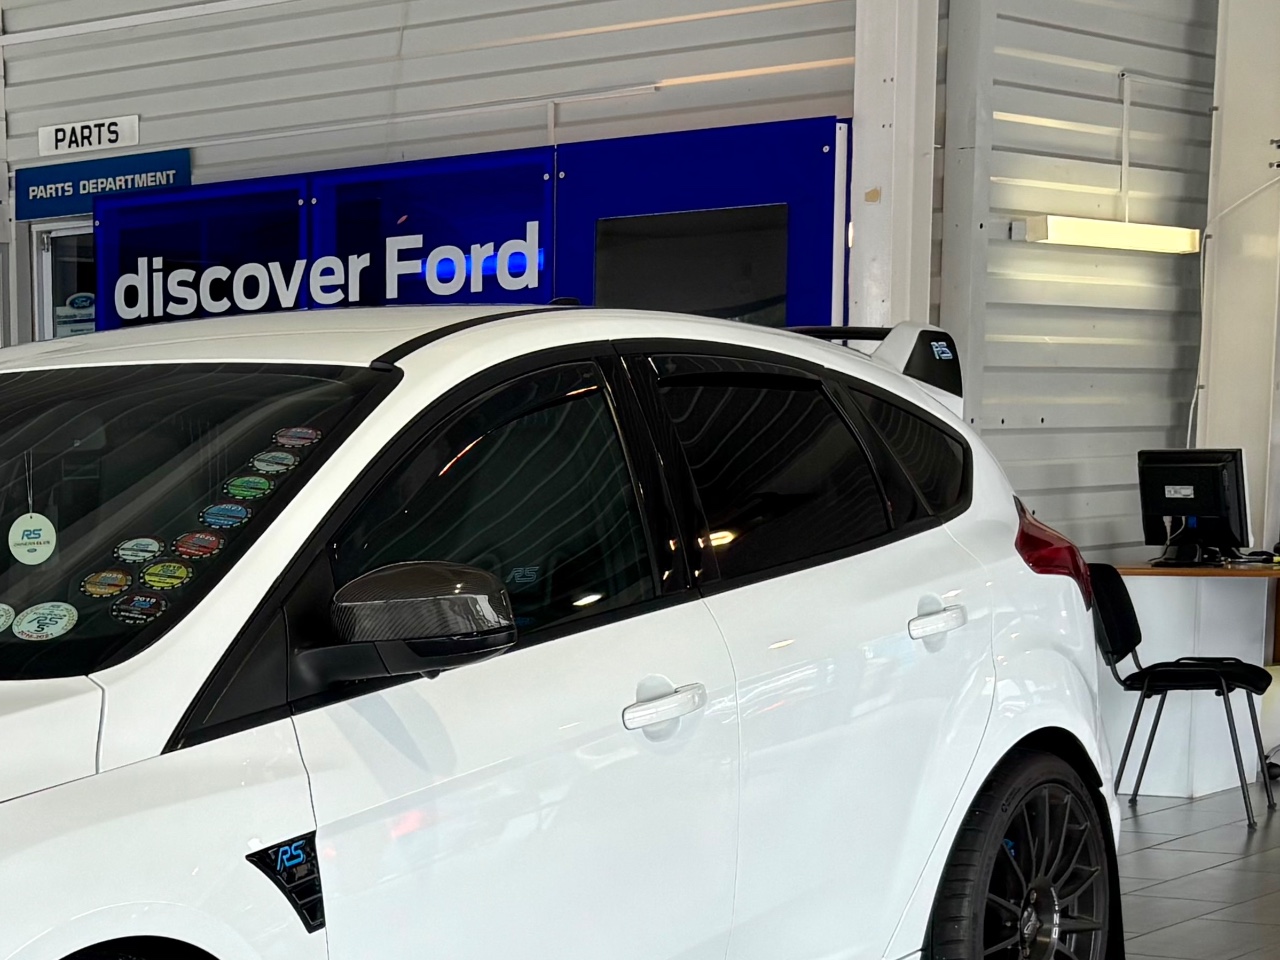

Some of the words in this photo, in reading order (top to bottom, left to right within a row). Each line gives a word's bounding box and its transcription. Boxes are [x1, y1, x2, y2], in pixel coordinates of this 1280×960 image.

[53, 121, 119, 150] PARTS
[28, 181, 74, 200] PARTS
[78, 169, 176, 195] DEPARTMENT
[114, 253, 370, 320] discover
[385, 220, 540, 299] Ford
[930, 341, 953, 360] RS
[21, 528, 43, 541] RS
[506, 566, 540, 583] RS
[27, 615, 64, 626] RS
[277, 840, 306, 871] RS
